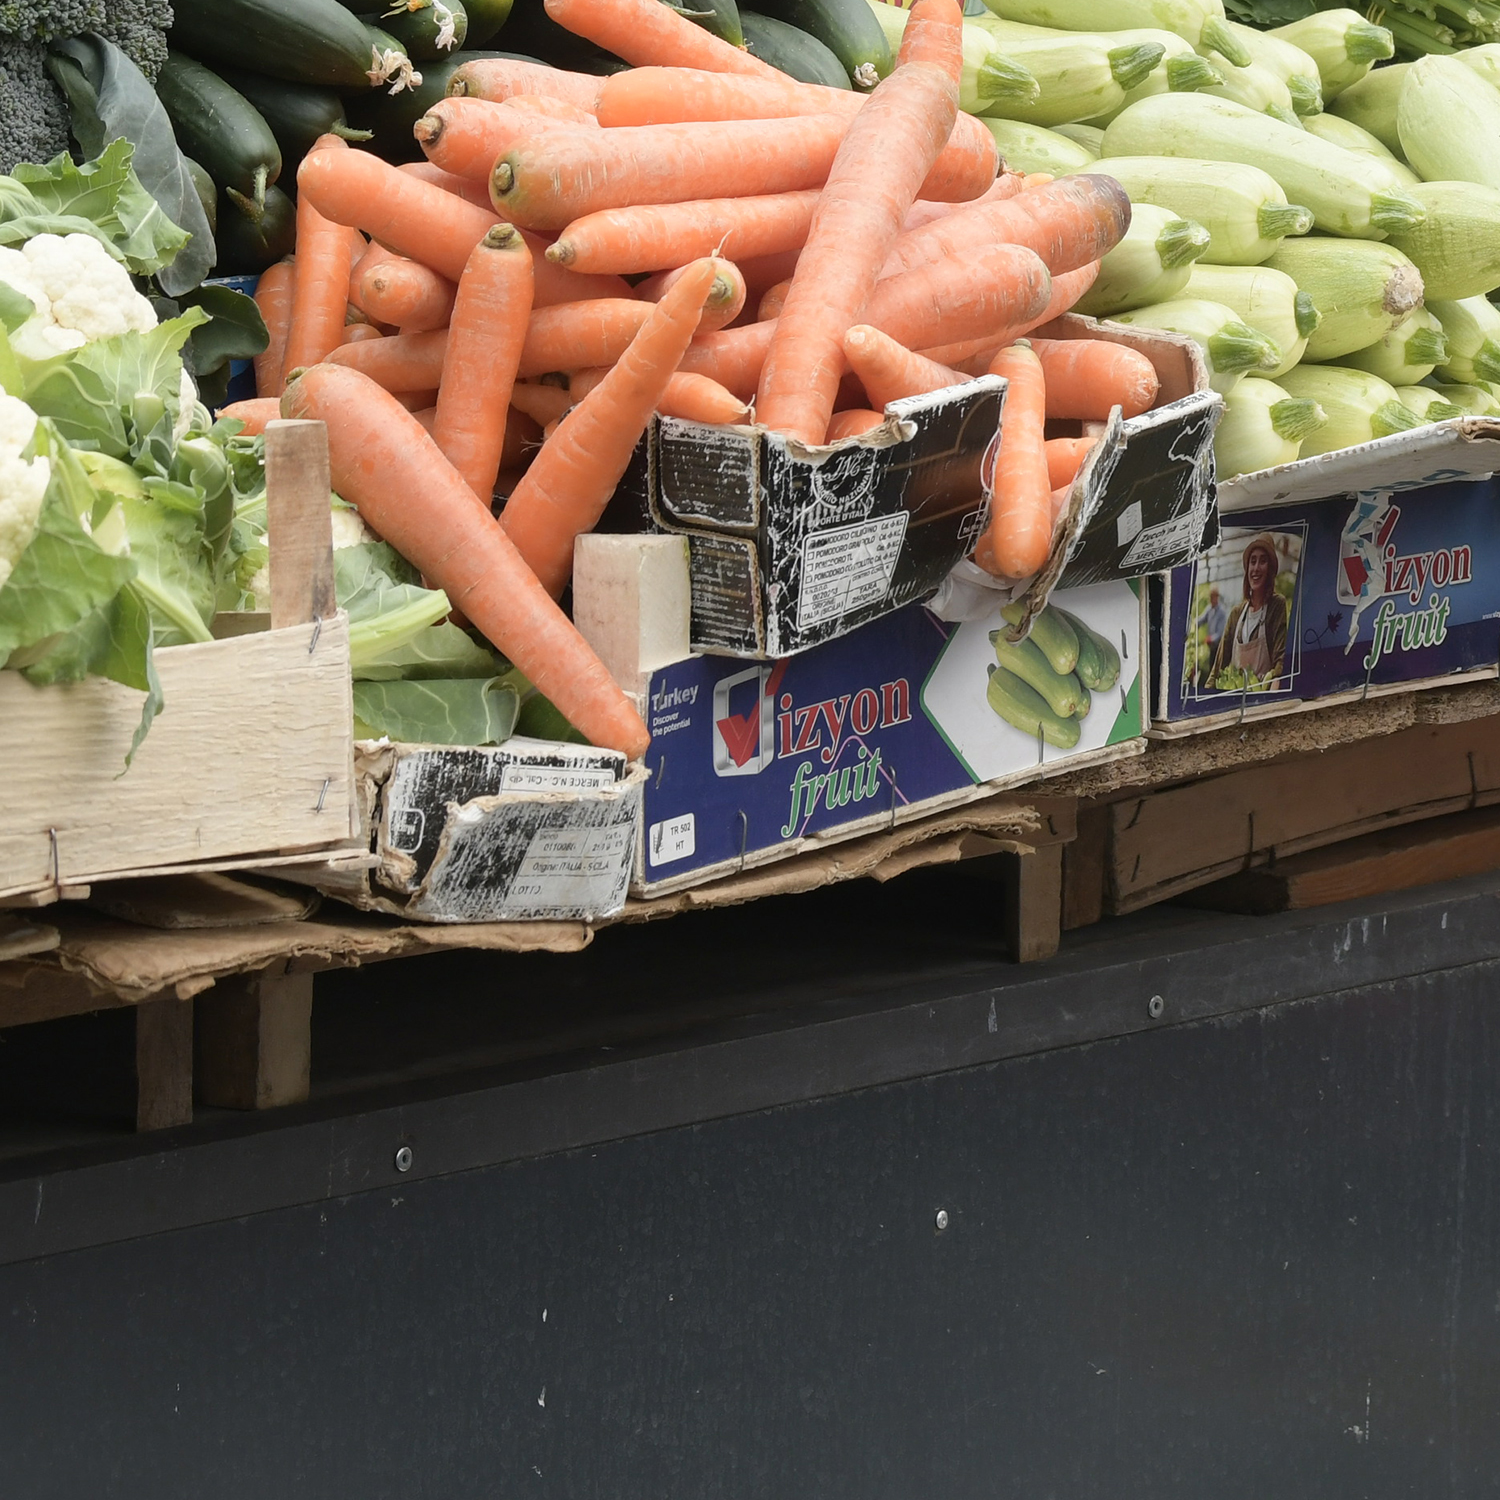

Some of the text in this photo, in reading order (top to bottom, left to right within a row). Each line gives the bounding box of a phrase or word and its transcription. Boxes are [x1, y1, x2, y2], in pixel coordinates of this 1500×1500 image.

[1364, 593, 1450, 669] fruit
[652, 684, 699, 711] Turkey
[653, 712, 679, 727] Discover
[653, 717, 691, 737] the potential
[781, 747, 882, 838] fruit
[671, 822, 691, 836] TR 502
[676, 840, 685, 851] HT
